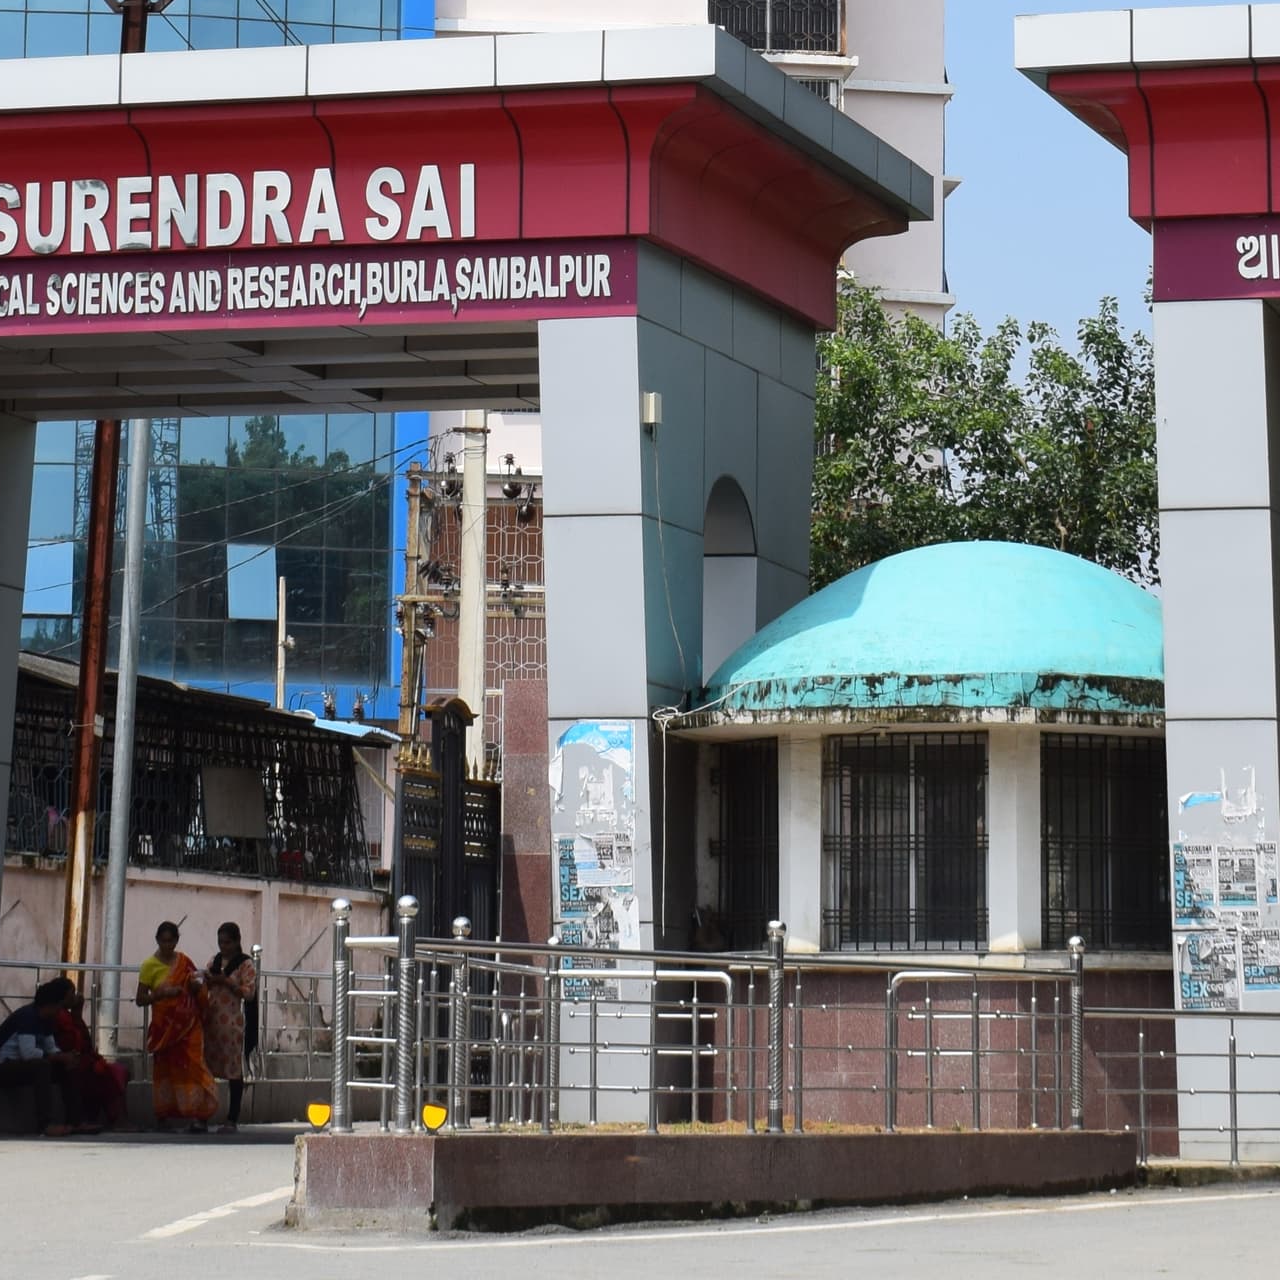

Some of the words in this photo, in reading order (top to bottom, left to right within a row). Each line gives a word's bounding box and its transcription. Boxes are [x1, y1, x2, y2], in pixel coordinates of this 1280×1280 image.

[364, 162, 476, 242] SAI
[45, 270, 166, 317] SCIENCES
[168, 268, 222, 314] AND
[561, 884, 586, 901] SEX
[1176, 890, 1193, 908] SE
[1244, 965, 1265, 977] SEX
[1181, 980, 1209, 998] SEX
